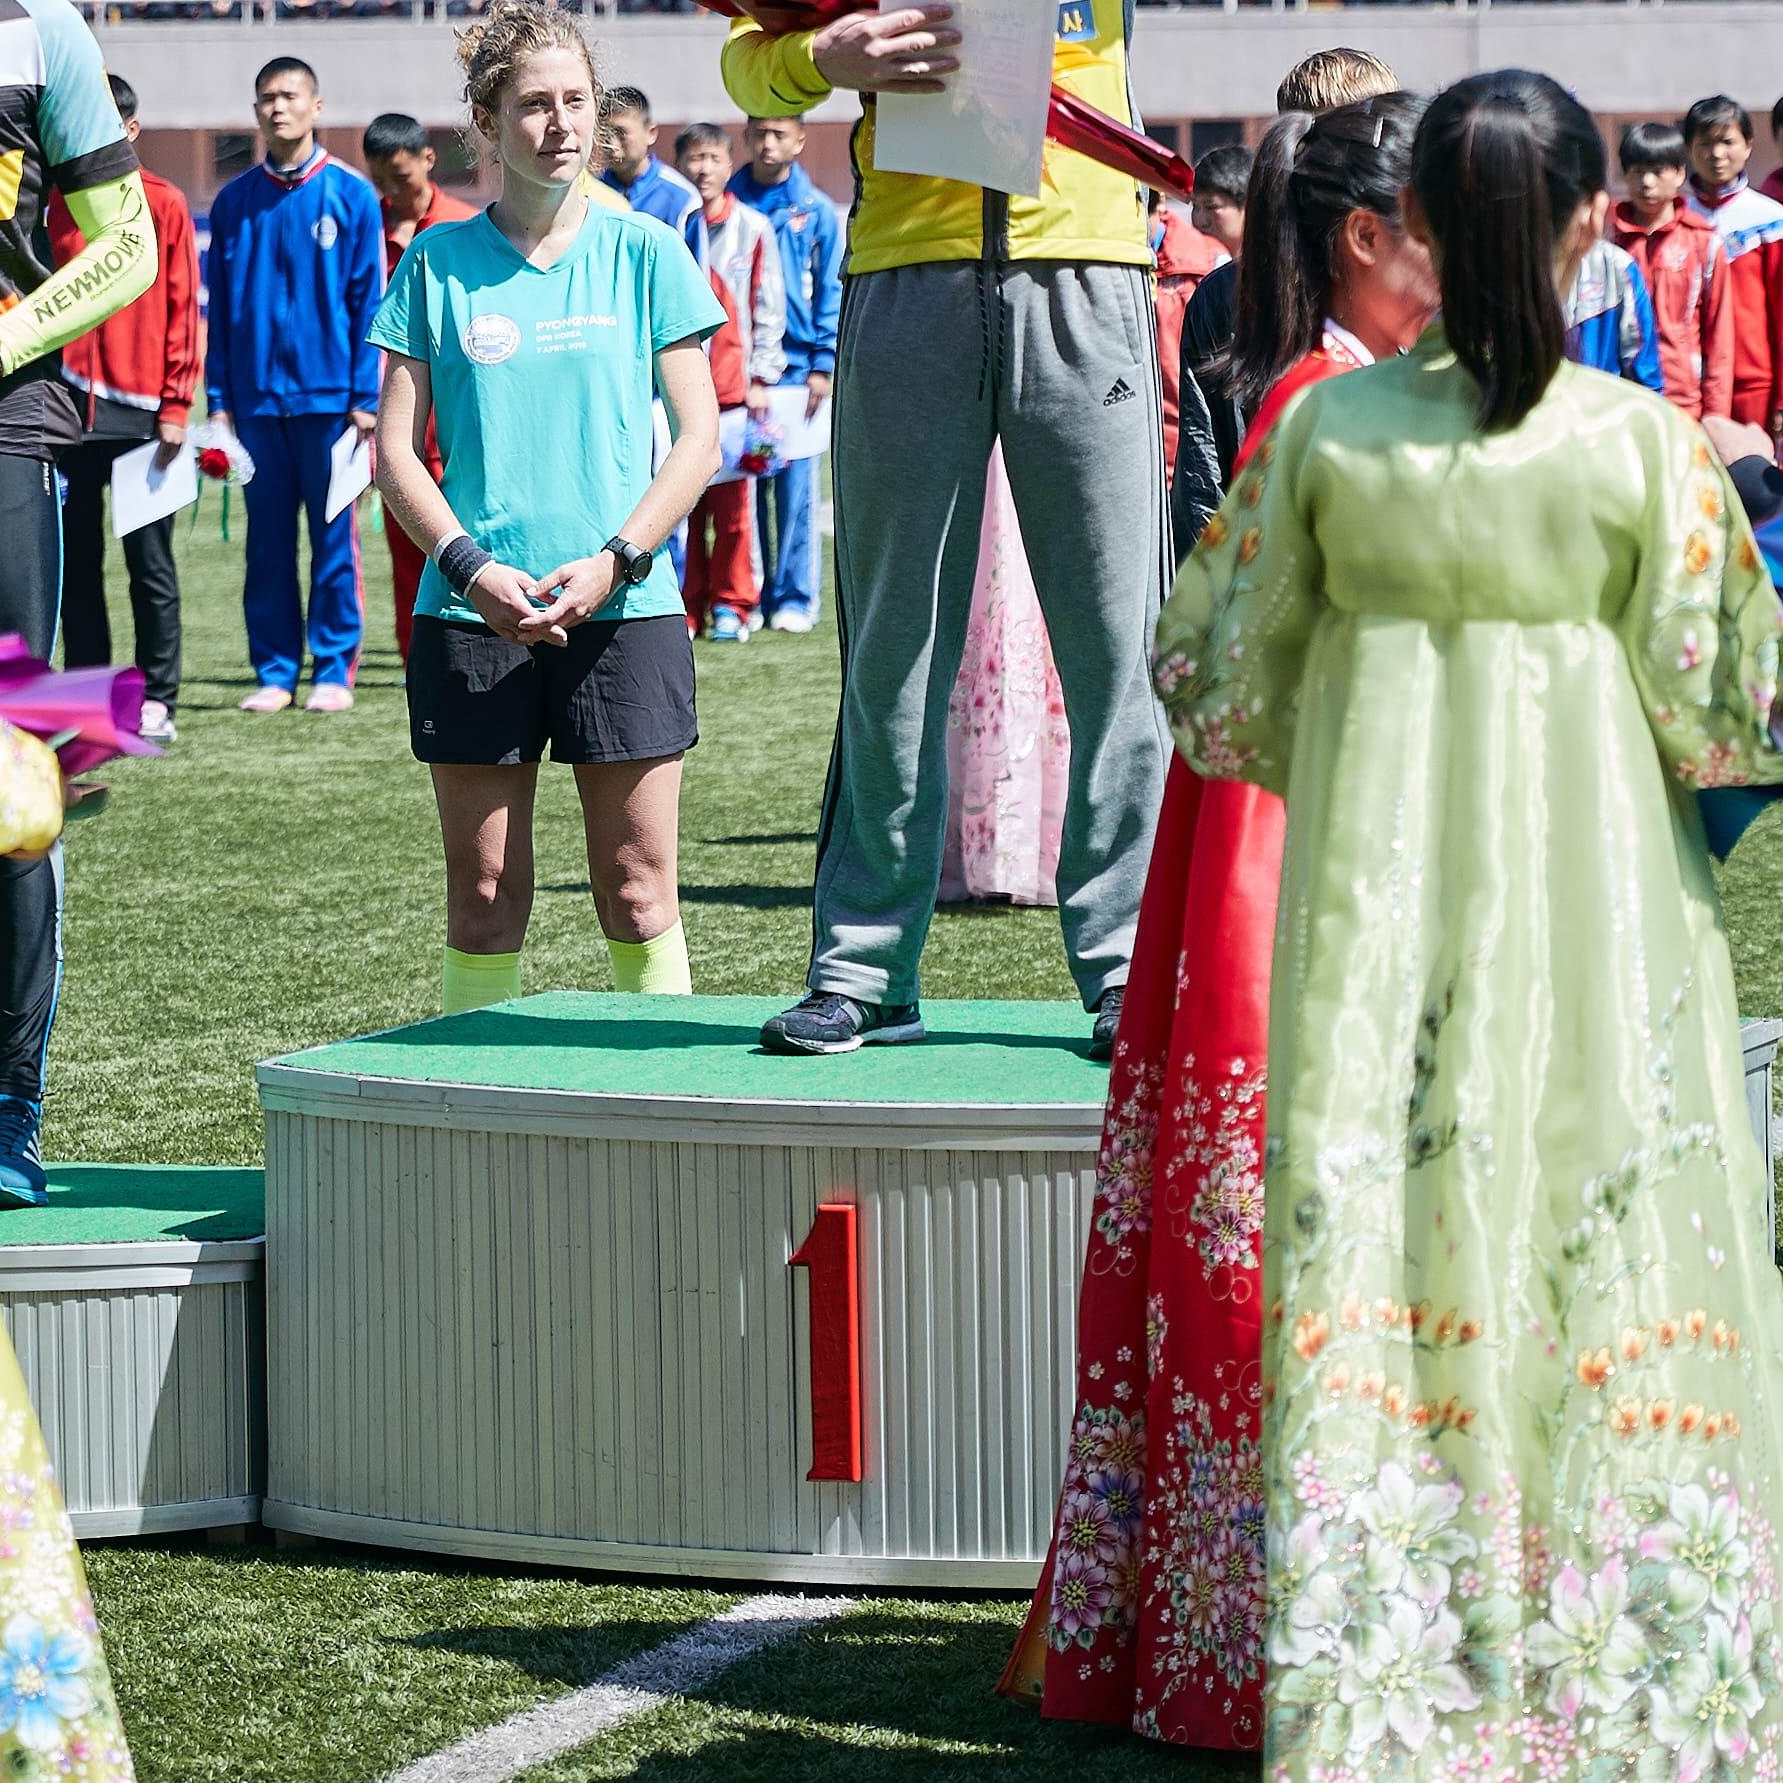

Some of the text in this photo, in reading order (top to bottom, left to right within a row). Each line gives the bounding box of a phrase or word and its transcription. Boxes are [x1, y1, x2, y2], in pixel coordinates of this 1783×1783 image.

[535, 314, 618, 332] PYONGYANG
[536, 330, 583, 343] DPR KOREA
[786, 1203, 861, 1481] 1
